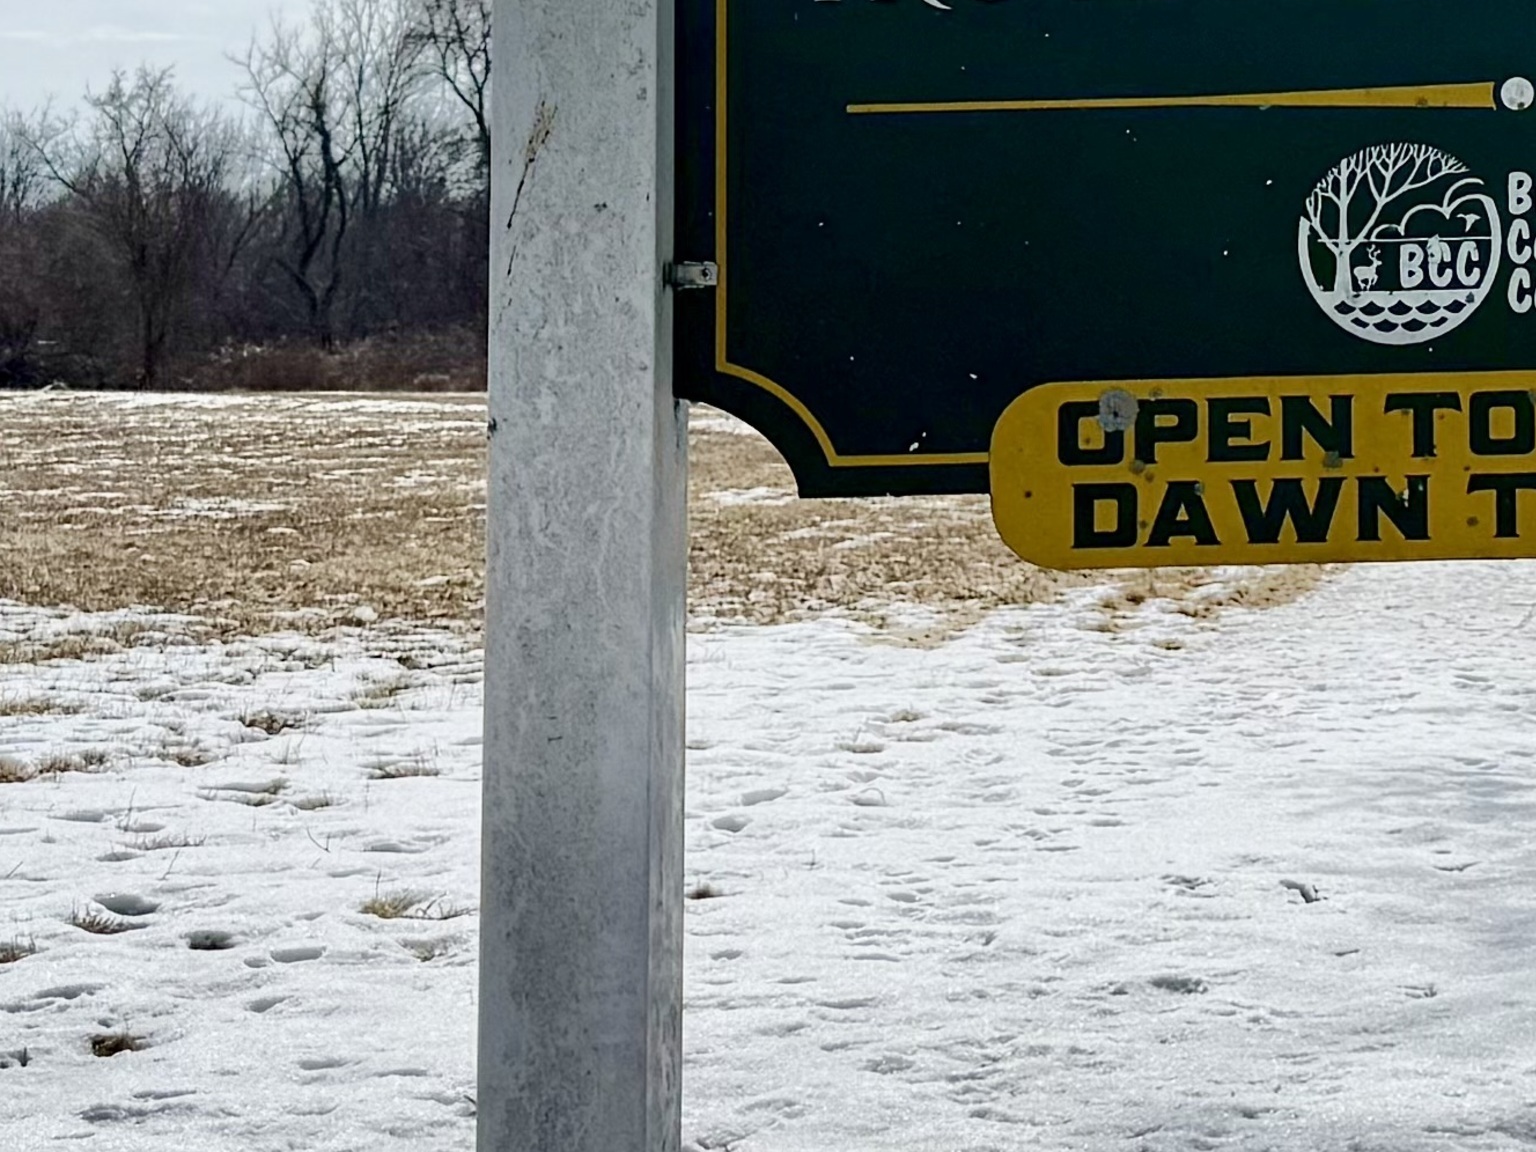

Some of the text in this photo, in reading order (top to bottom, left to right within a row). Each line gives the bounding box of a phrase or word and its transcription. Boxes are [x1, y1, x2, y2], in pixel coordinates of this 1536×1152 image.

[1399, 242, 1481, 289] BCC
[1057, 394, 1354, 467] OPEN
[1383, 389, 1536, 458] TO
[1070, 474, 1432, 549] DAWN
